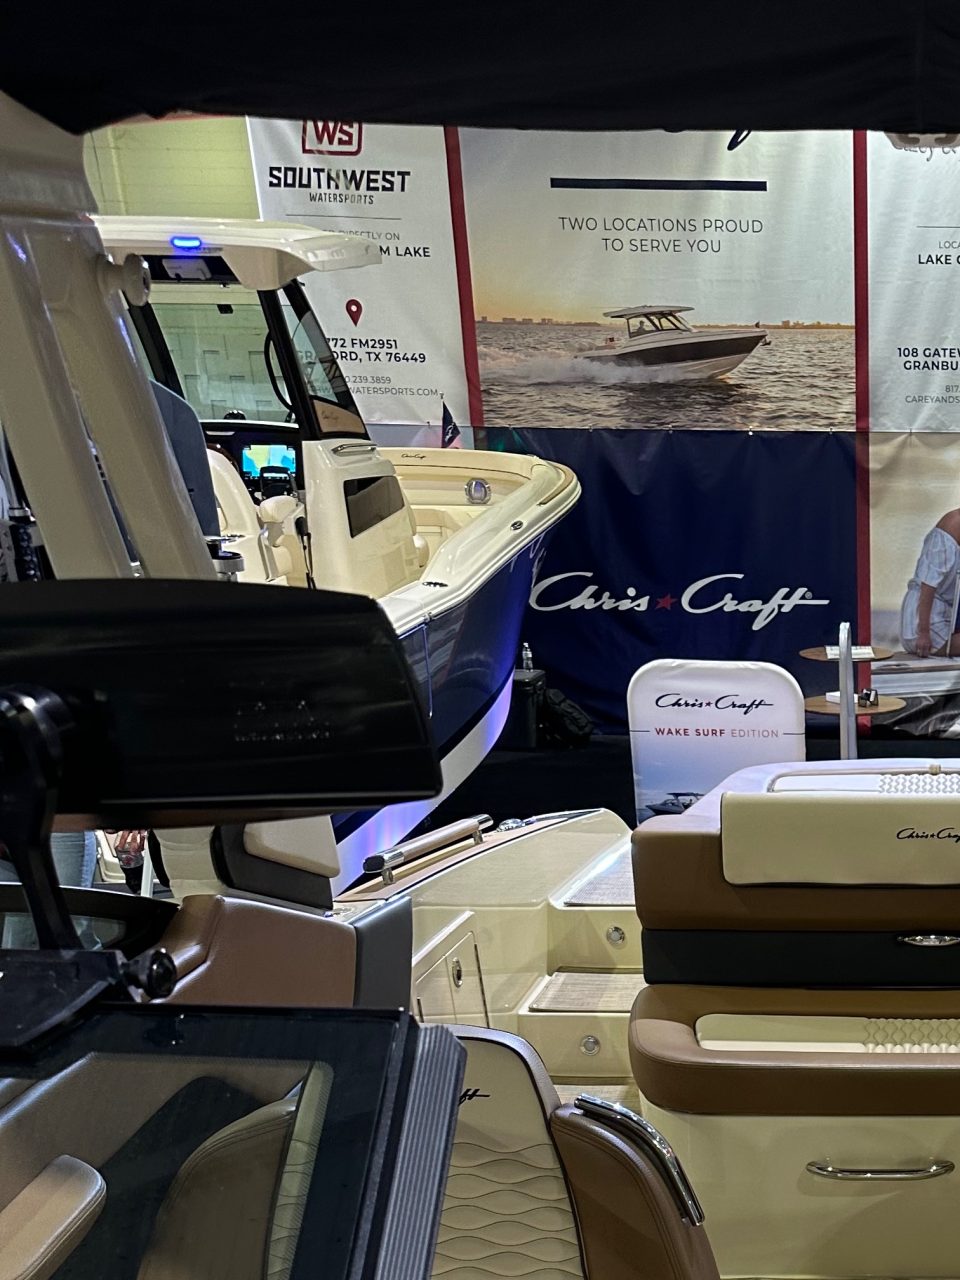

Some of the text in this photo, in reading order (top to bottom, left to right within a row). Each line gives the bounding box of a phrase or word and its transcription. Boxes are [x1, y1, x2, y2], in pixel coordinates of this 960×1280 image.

[312, 119, 354, 146] WS
[268, 166, 411, 192] SOUTHWEST
[309, 192, 375, 205] WATERSPORTS
[558, 216, 764, 233] TWO LOCATIONS PROUD
[385, 232, 400, 241] ON
[395, 246, 431, 258] LAKE
[602, 238, 721, 253] TO SERVE YOU
[918, 253, 952, 265] LAKE
[351, 338, 398, 350] FM2951
[365, 351, 381, 362] TX
[385, 352, 426, 363] 76449
[897, 347, 919, 358] 108
[528, 571, 650, 612] Chris
[655, 693, 774, 715] Chris Craft
[655, 727, 779, 738] WAKE SURF EDITION
[896, 827, 929, 840] Chris
